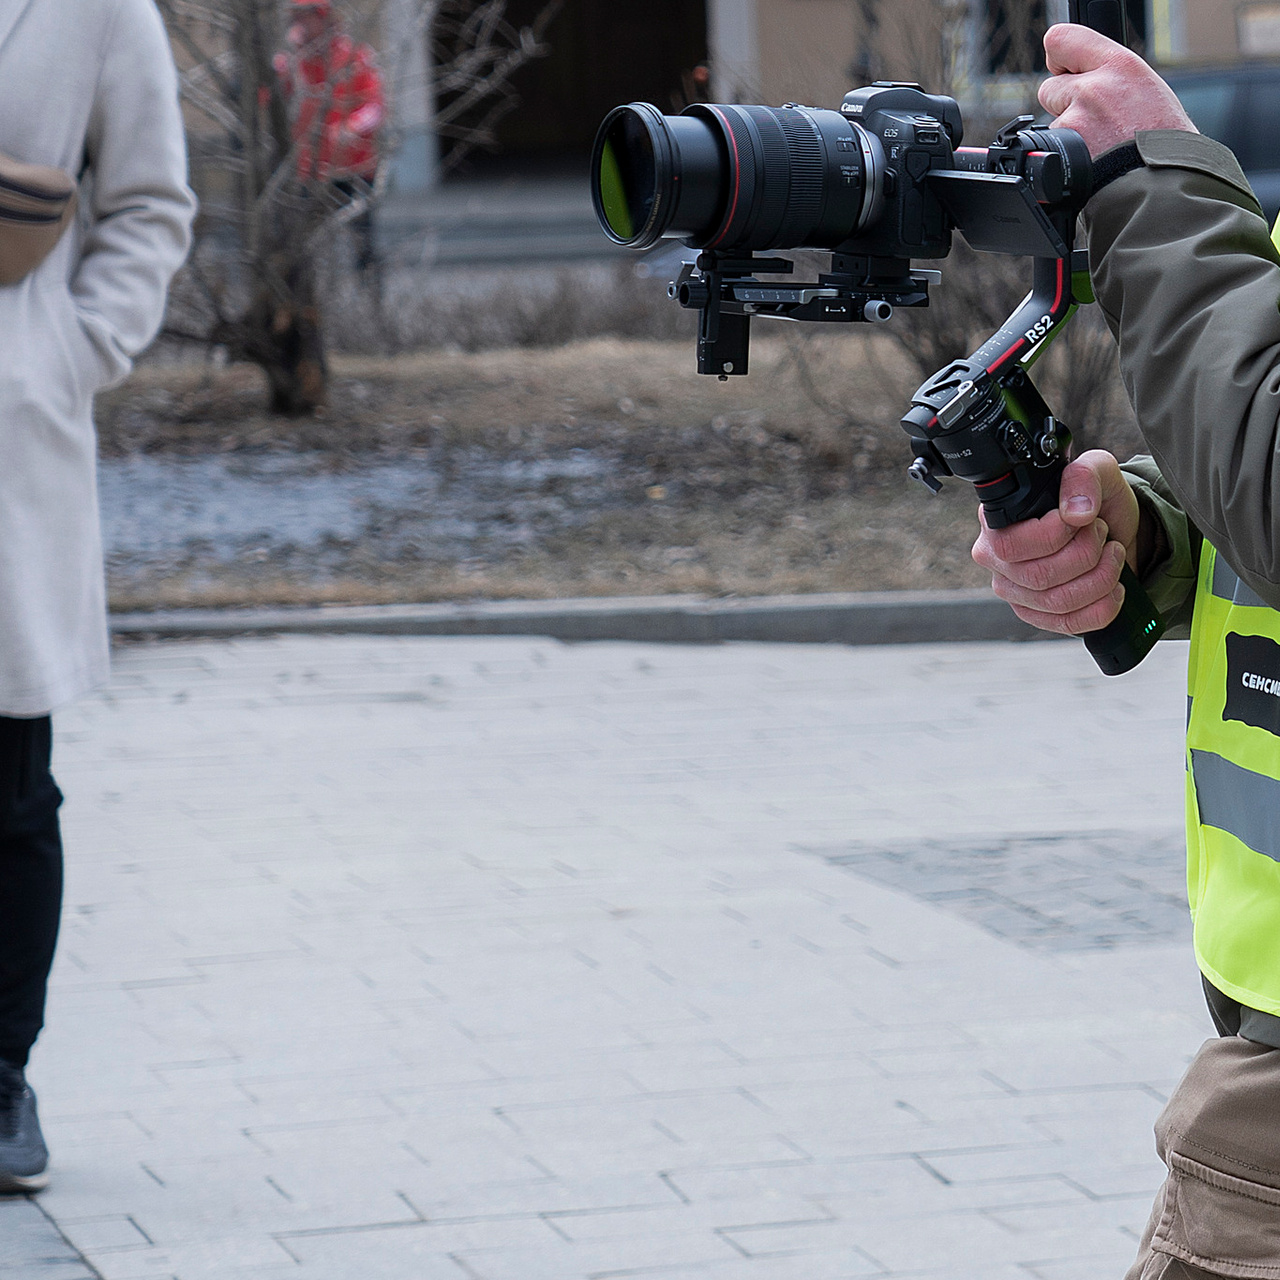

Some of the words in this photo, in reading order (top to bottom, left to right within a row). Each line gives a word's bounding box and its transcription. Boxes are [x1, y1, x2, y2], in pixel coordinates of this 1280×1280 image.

[840, 102, 864, 113] Canon
[883, 128, 899, 138] EOS
[1024, 314, 1054, 344] RS2
